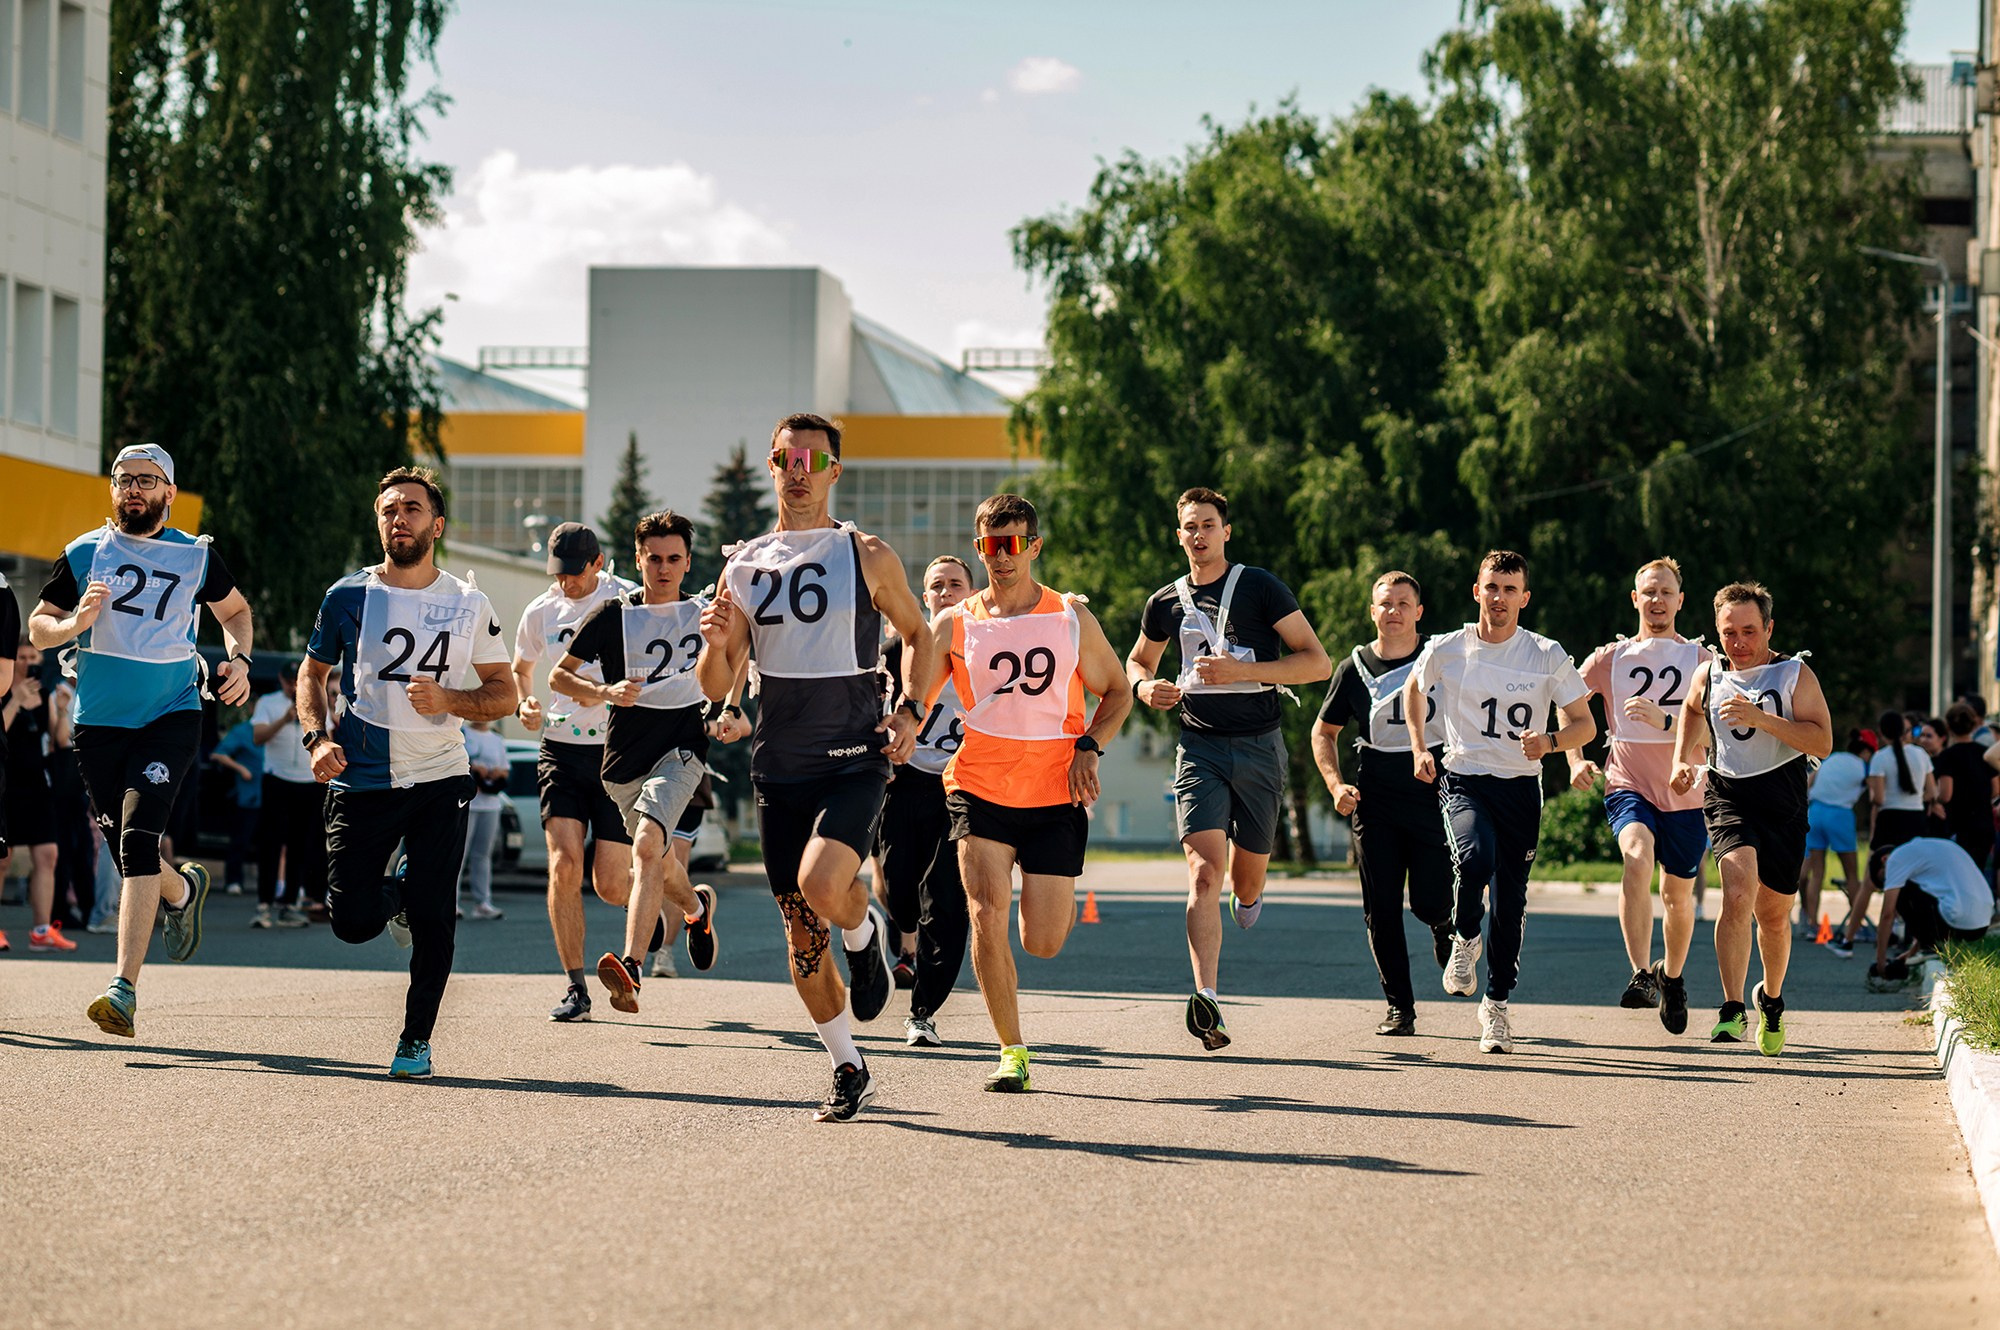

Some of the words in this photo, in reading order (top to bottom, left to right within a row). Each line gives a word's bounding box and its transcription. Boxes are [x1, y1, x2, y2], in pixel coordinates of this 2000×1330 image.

[112, 564, 181, 621] 27
[751, 562, 828, 626] 26
[378, 627, 451, 683] 24
[645, 634, 703, 684] 23
[989, 647, 1056, 696] 29
[1629, 665, 1684, 706] 22
[916, 703, 965, 754] 18
[1481, 697, 1533, 741] 19
